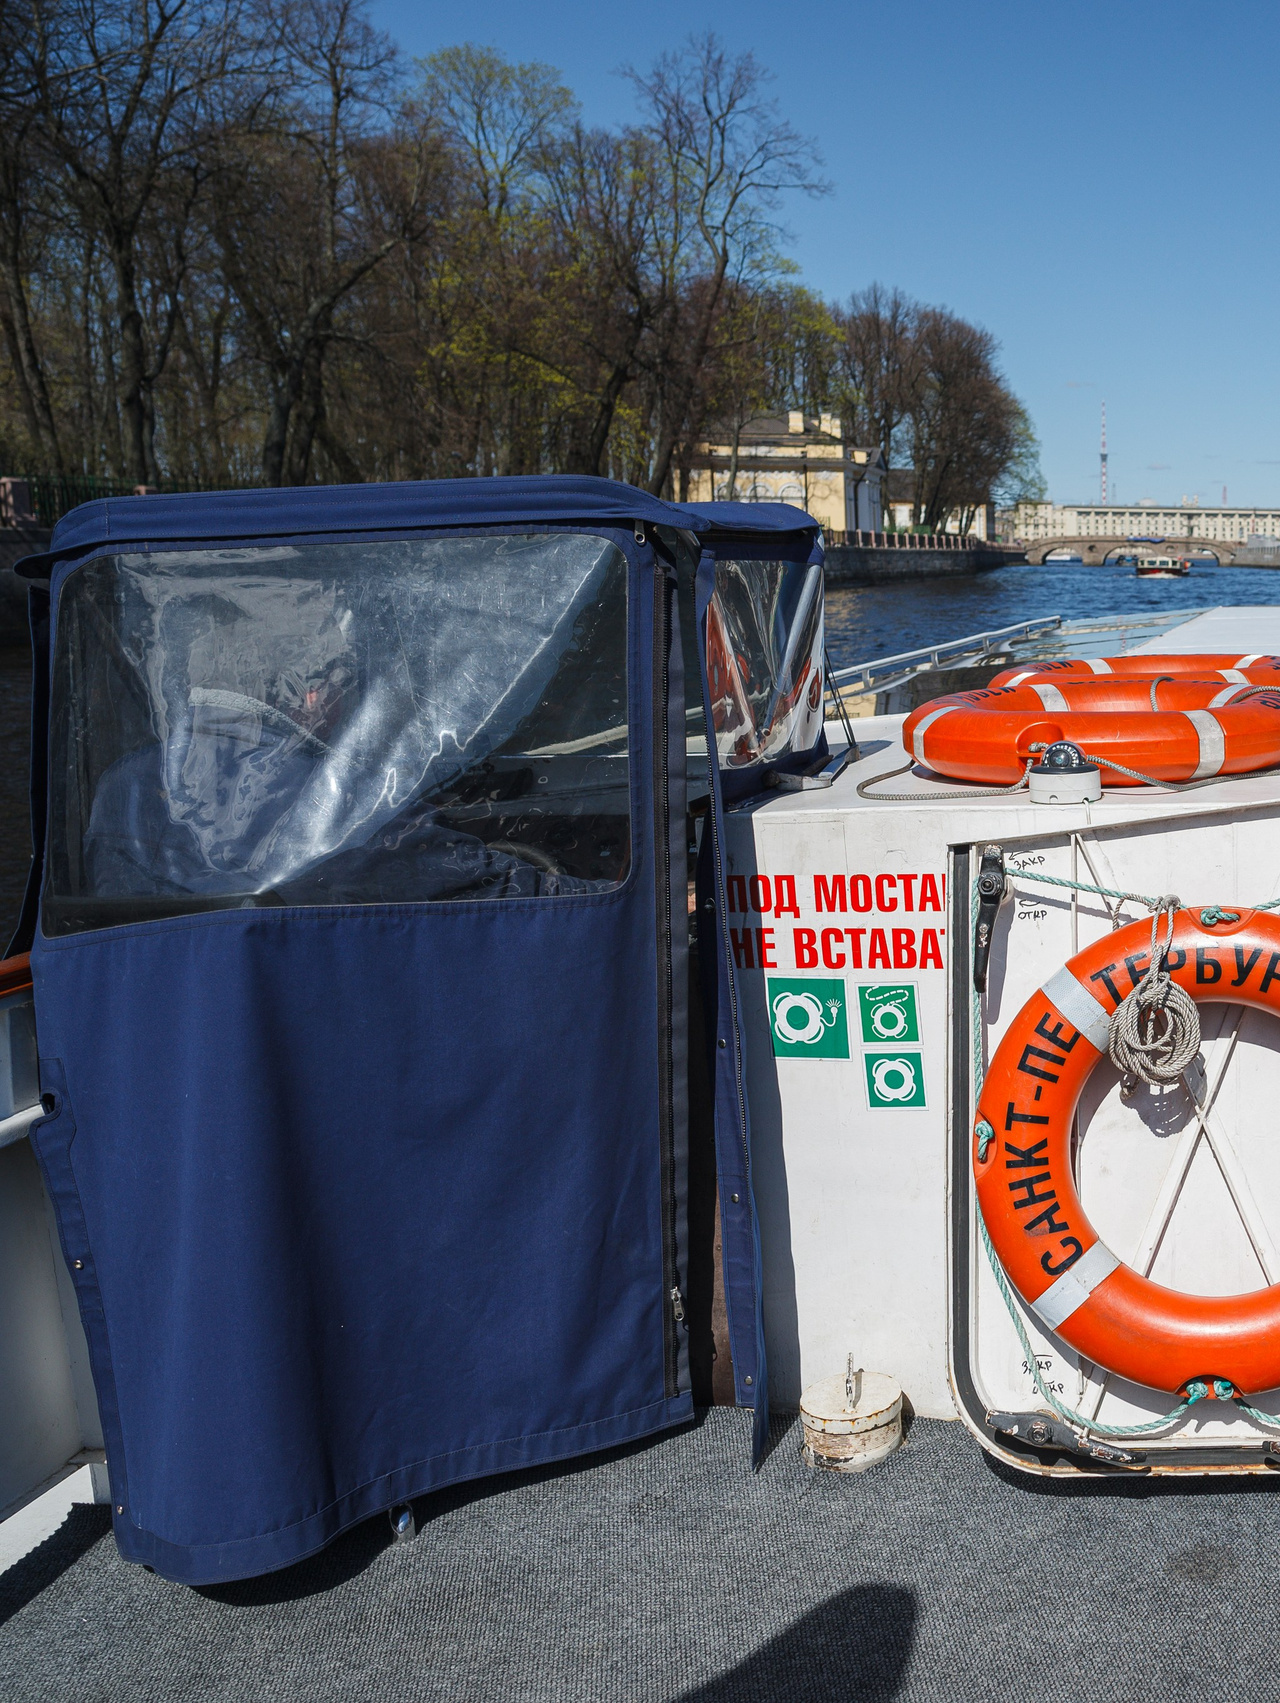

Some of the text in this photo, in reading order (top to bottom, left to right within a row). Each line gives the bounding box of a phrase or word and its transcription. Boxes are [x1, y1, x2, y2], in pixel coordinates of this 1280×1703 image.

[1014, 855, 1046, 871] ЗАКР
[727, 873, 946, 919] ПОД МОСТА
[1018, 909, 1048, 921] ОТКР
[730, 927, 777, 969] НЕ
[1021, 1360, 1052, 1374] ЗКР
[1032, 1384, 1064, 1395] ОКР
